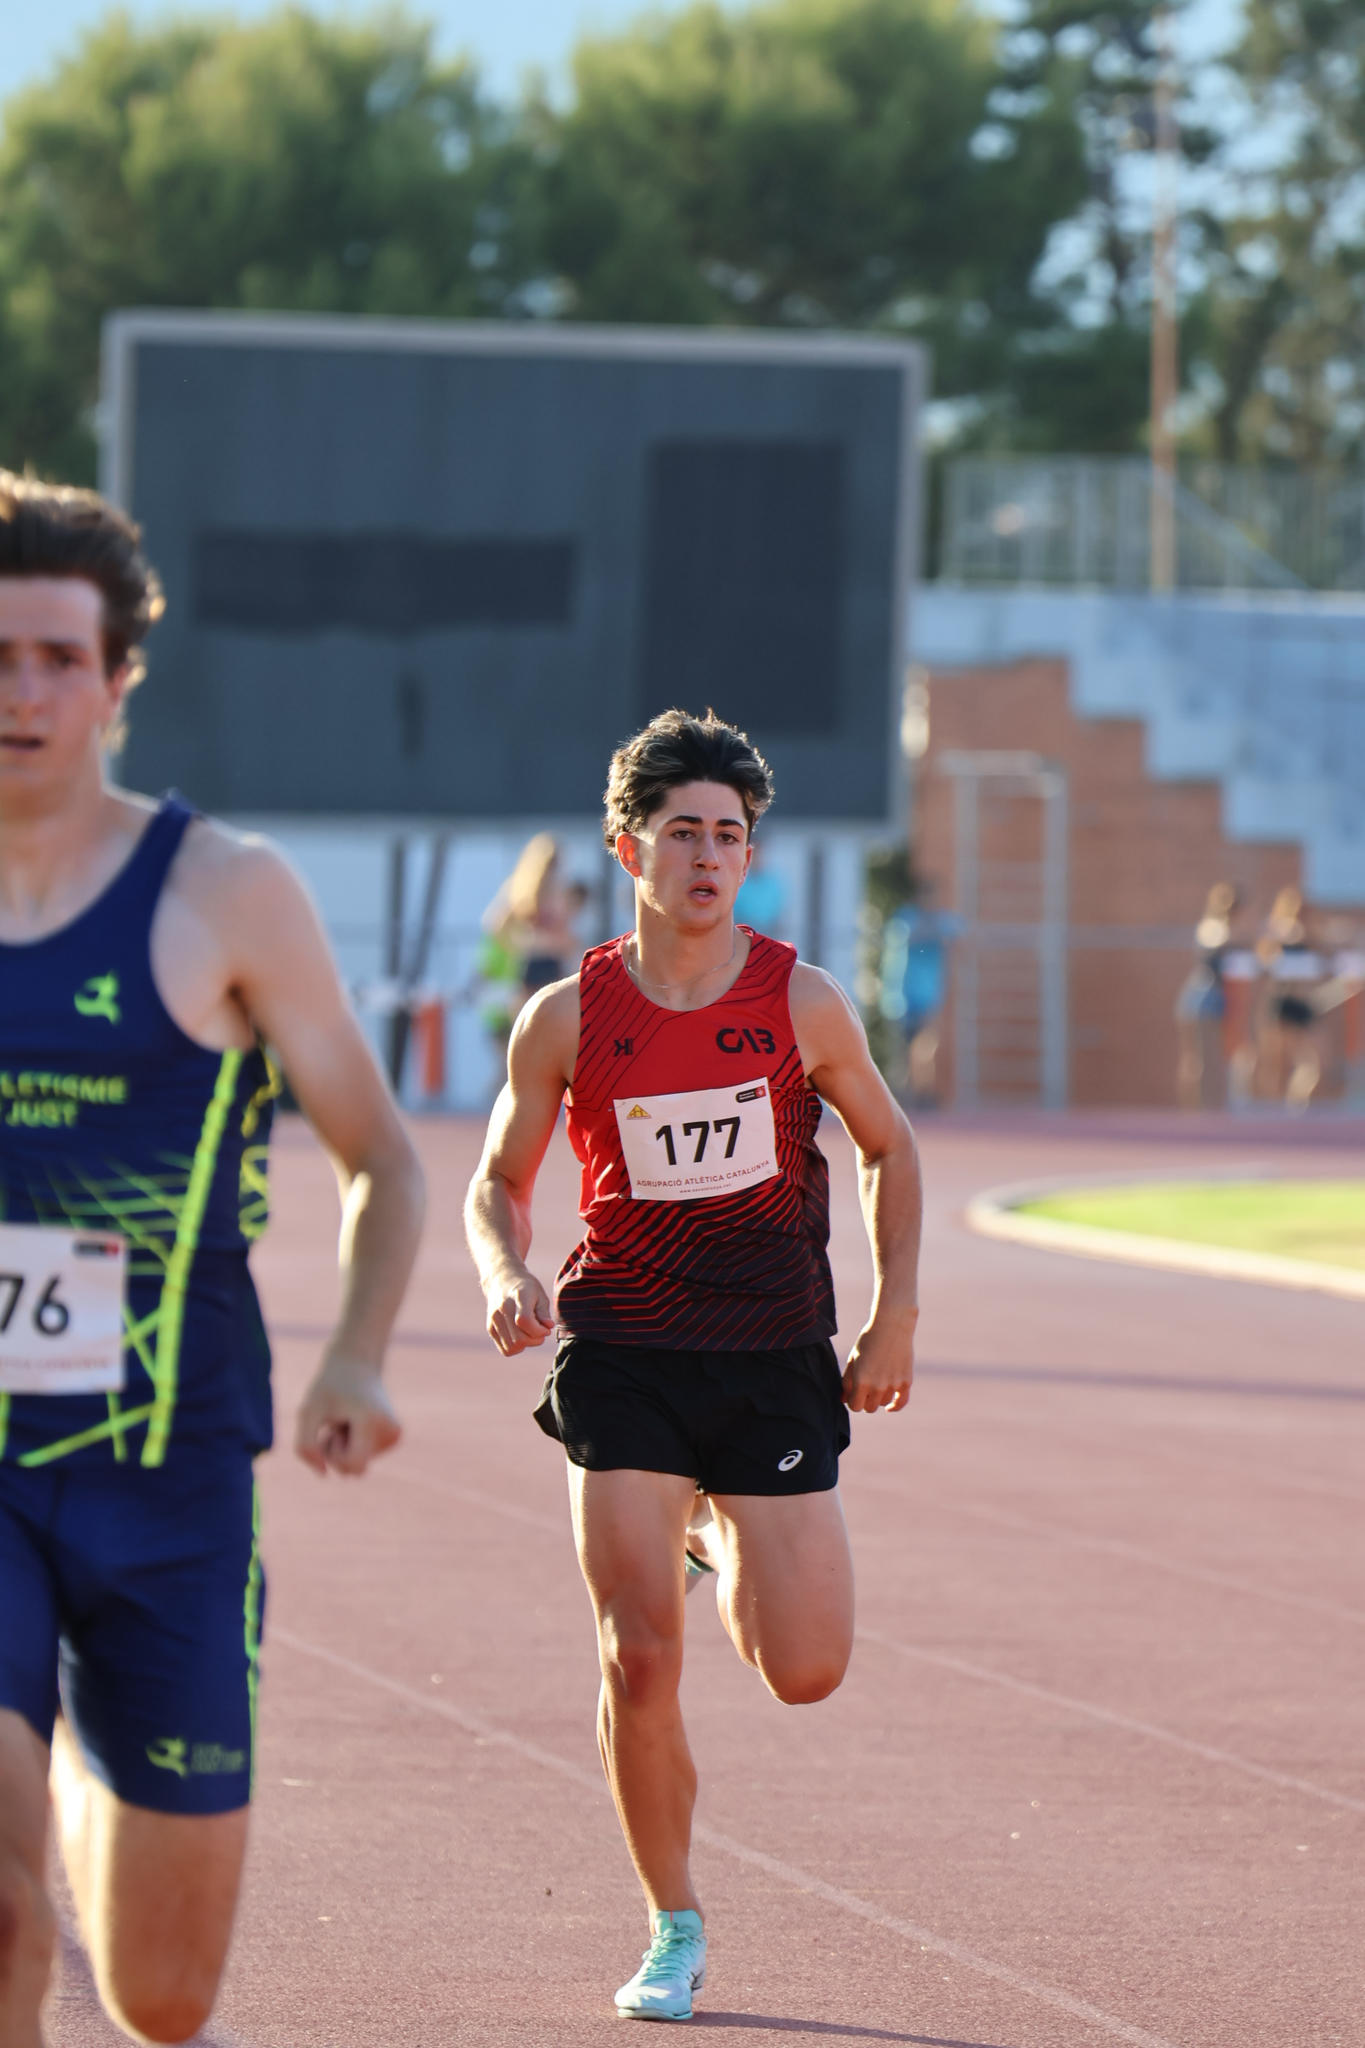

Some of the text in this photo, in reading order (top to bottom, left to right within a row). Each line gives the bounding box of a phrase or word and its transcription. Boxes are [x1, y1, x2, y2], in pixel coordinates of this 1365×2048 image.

[716, 1028, 777, 1055] CAB
[6, 1101, 78, 1128] JUST
[655, 1116, 741, 1166] 177
[726, 1160, 770, 1180] CATALUNYA
[0, 1273, 70, 1338] 76
